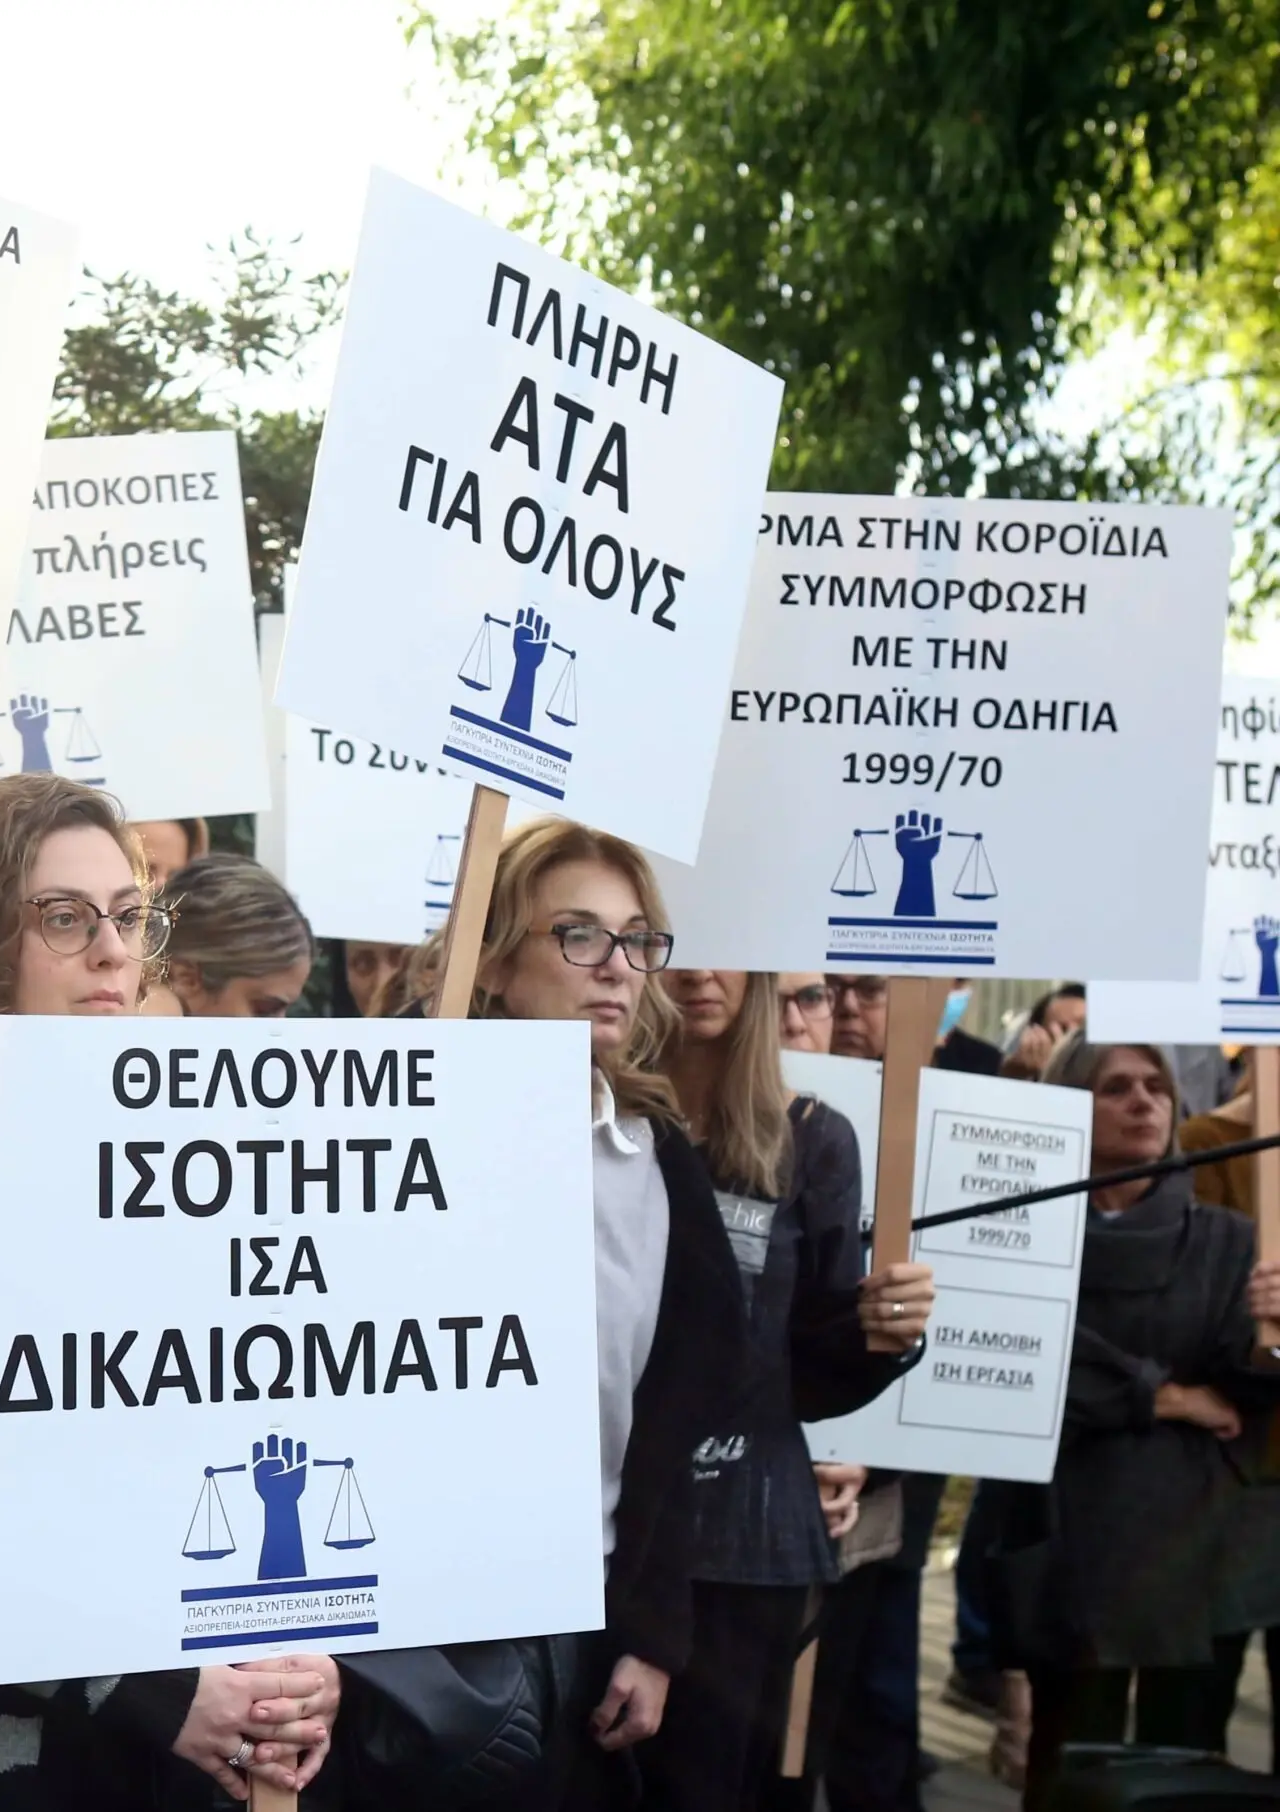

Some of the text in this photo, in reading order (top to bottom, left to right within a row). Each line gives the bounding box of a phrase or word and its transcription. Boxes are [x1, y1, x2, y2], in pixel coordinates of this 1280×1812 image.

[487, 262, 678, 415] ΠΛΗΡΗ
[490, 376, 628, 513] ΑΤΑ
[33, 532, 206, 579] πλήρεις
[399, 445, 685, 631] ΓΙΑ ΟΛΟΥΣ
[857, 518, 960, 551] ΣΤΗΝ
[977, 517, 1168, 558] ΚΟΡΟΪΔΙΑ
[780, 574, 1086, 614] ΣΥΜΜΟΡΦΩΣΗ
[853, 636, 1007, 670] ΜΕ ΤΗΝ
[731, 687, 1117, 732] ΕΥΡΩΠΑΪΚΗ ΟΔΗΓΙΑ
[1222, 698, 1280, 740] ηφί
[310, 728, 355, 765] Το
[843, 752, 1002, 792] 1999/70
[113, 1048, 435, 1109] ΘΕΛΟΥΜΕ
[951, 1123, 1065, 1149] ΣΥΜΜΟΡΦΩΣΗ
[99, 1138, 447, 1218] ΙΣΟΤΗΤΑ
[978, 1152, 1035, 1172] ΜΕ ΤΗΝ
[969, 1227, 1030, 1247] 1999/70
[231, 1236, 328, 1296] ΙΣΑ
[936, 1327, 1041, 1350] ΙΣΗ ΑΜΟΙΒΗ
[934, 1363, 1033, 1385] ΙΣΗ ΕΡΓΑΣΙΑ
[188, 1593, 374, 1618] ΠΑΓΚΥΠΡΙΑ ΣΥΝΤΕΧΝΙΑ ΙΣΟΤΗΤΑ
